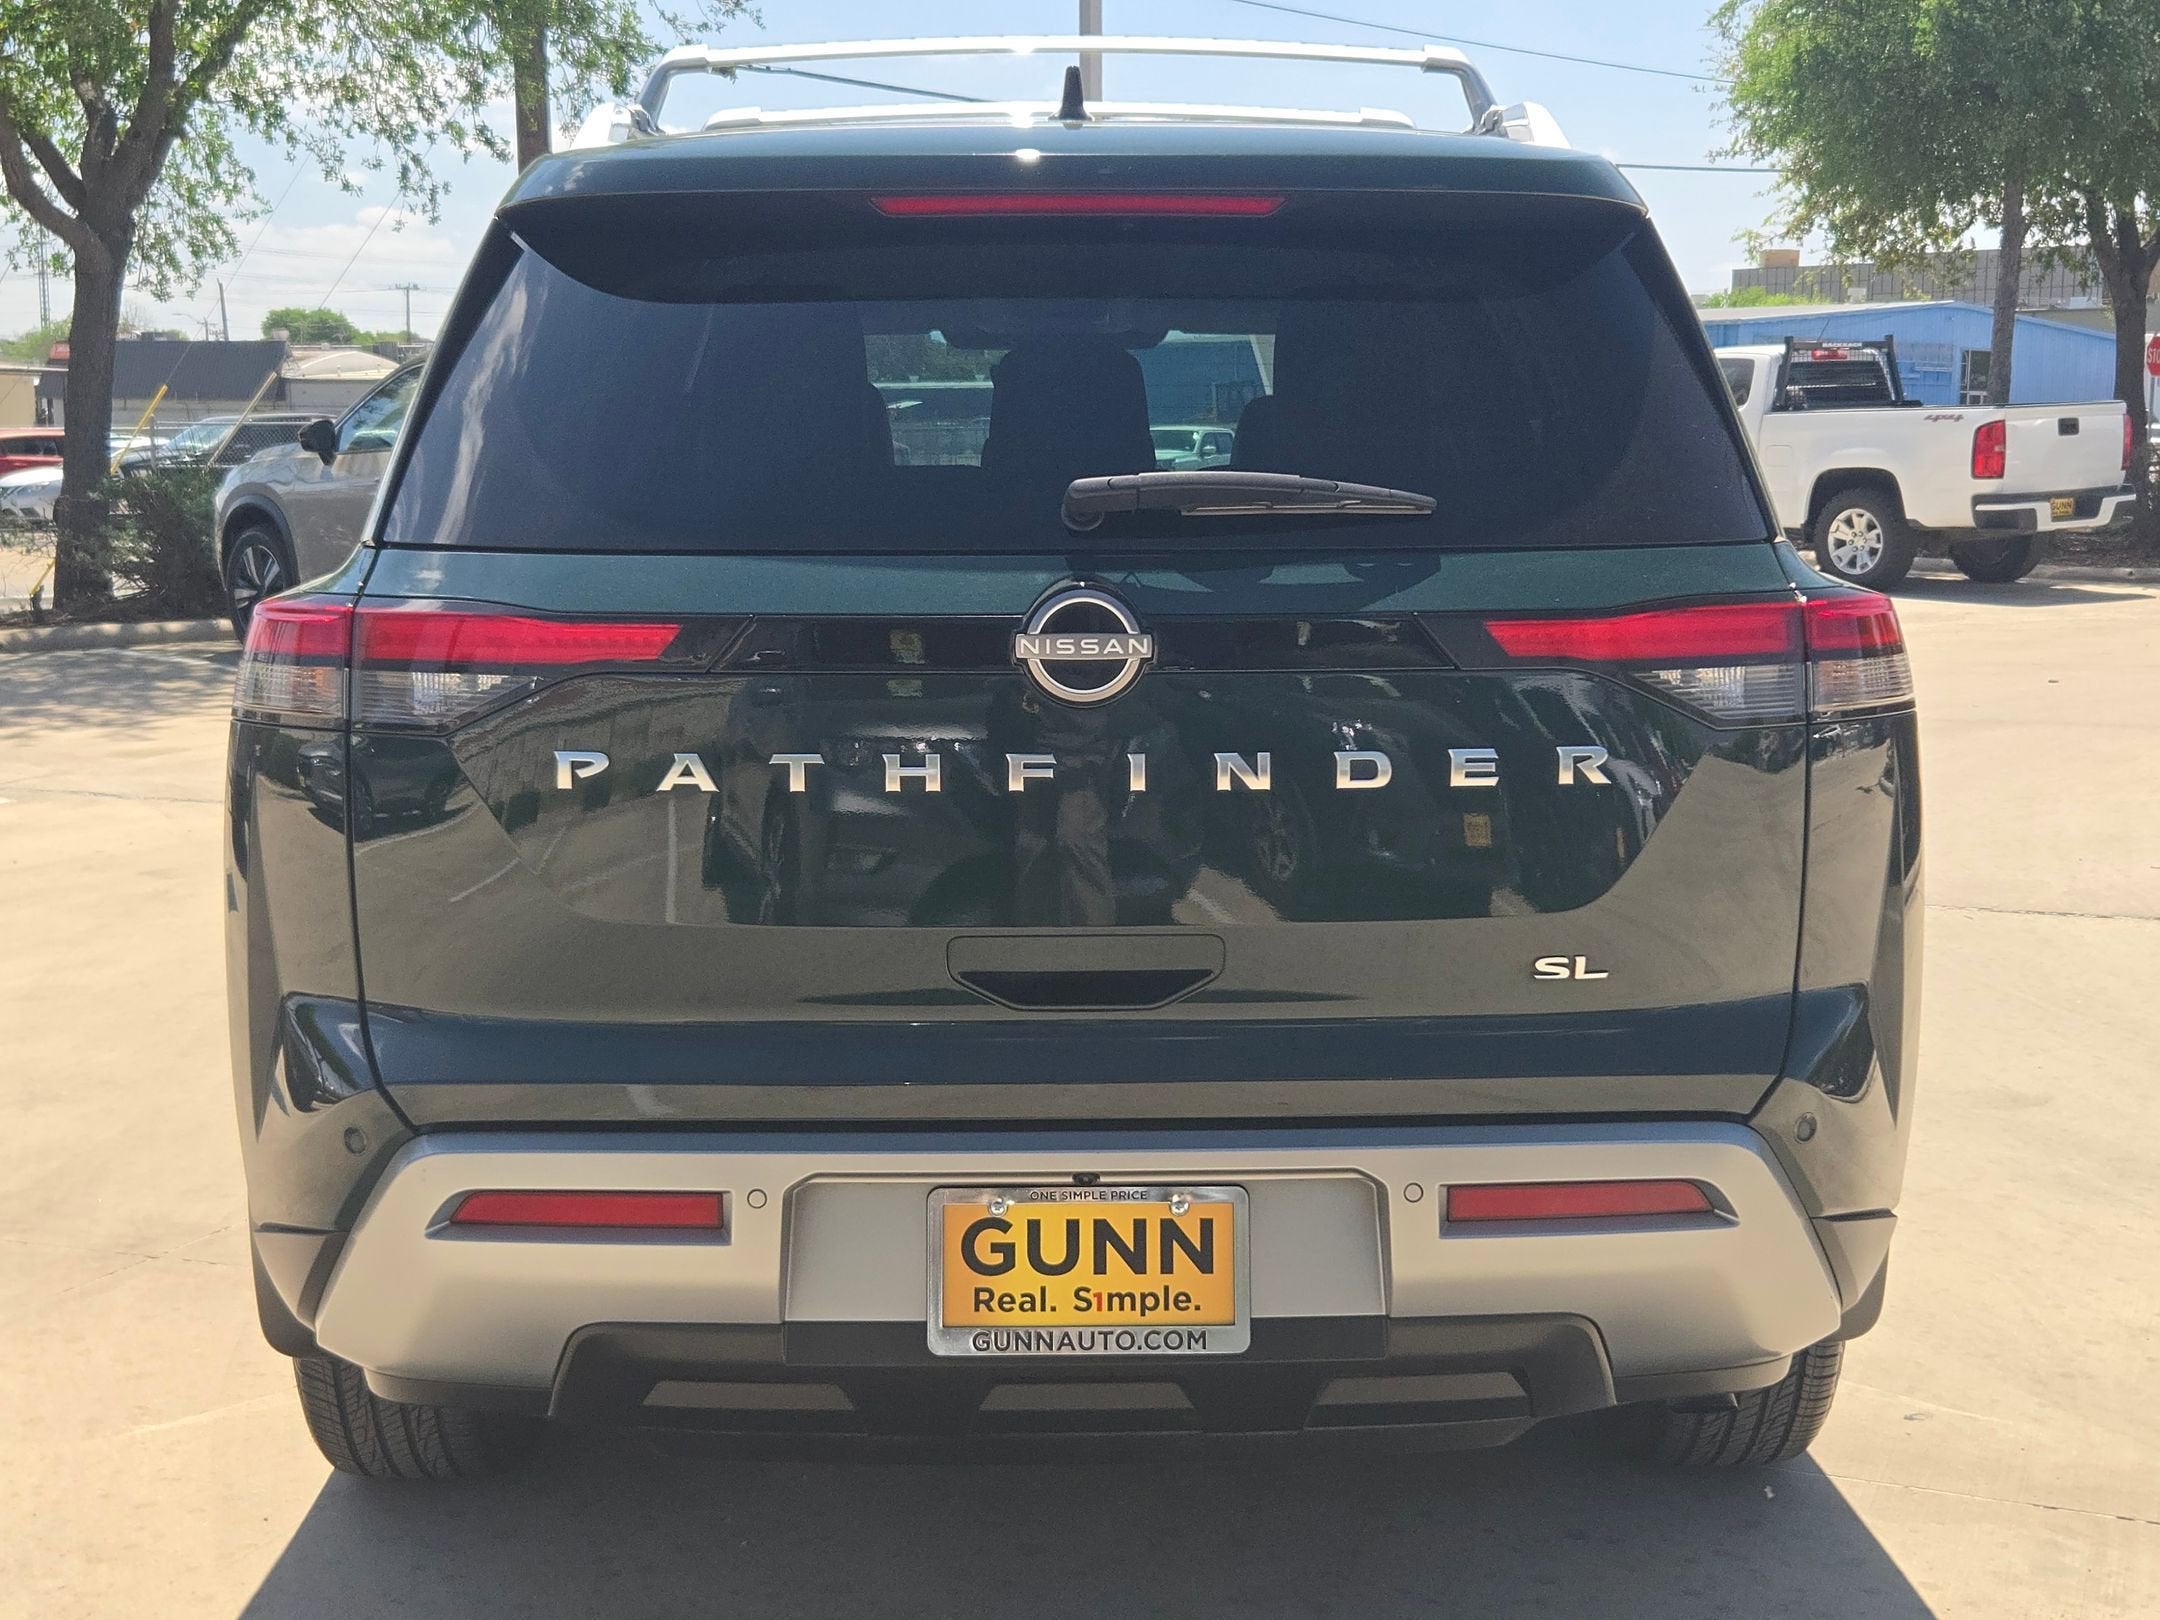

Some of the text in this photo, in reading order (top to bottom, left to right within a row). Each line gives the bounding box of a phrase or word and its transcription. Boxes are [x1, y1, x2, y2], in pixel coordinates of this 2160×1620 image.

[1020, 638, 1148, 654] NISSAN
[553, 746, 1613, 792] PATHFINDER
[1533, 956, 1609, 980] SL
[1030, 1190, 1148, 1200] ONE SIMPLE PRICE
[961, 1216, 1214, 1276] GUNN
[973, 1286, 1057, 1313] Real.
[972, 1329, 1208, 1352] GUNNAUTO.COM
